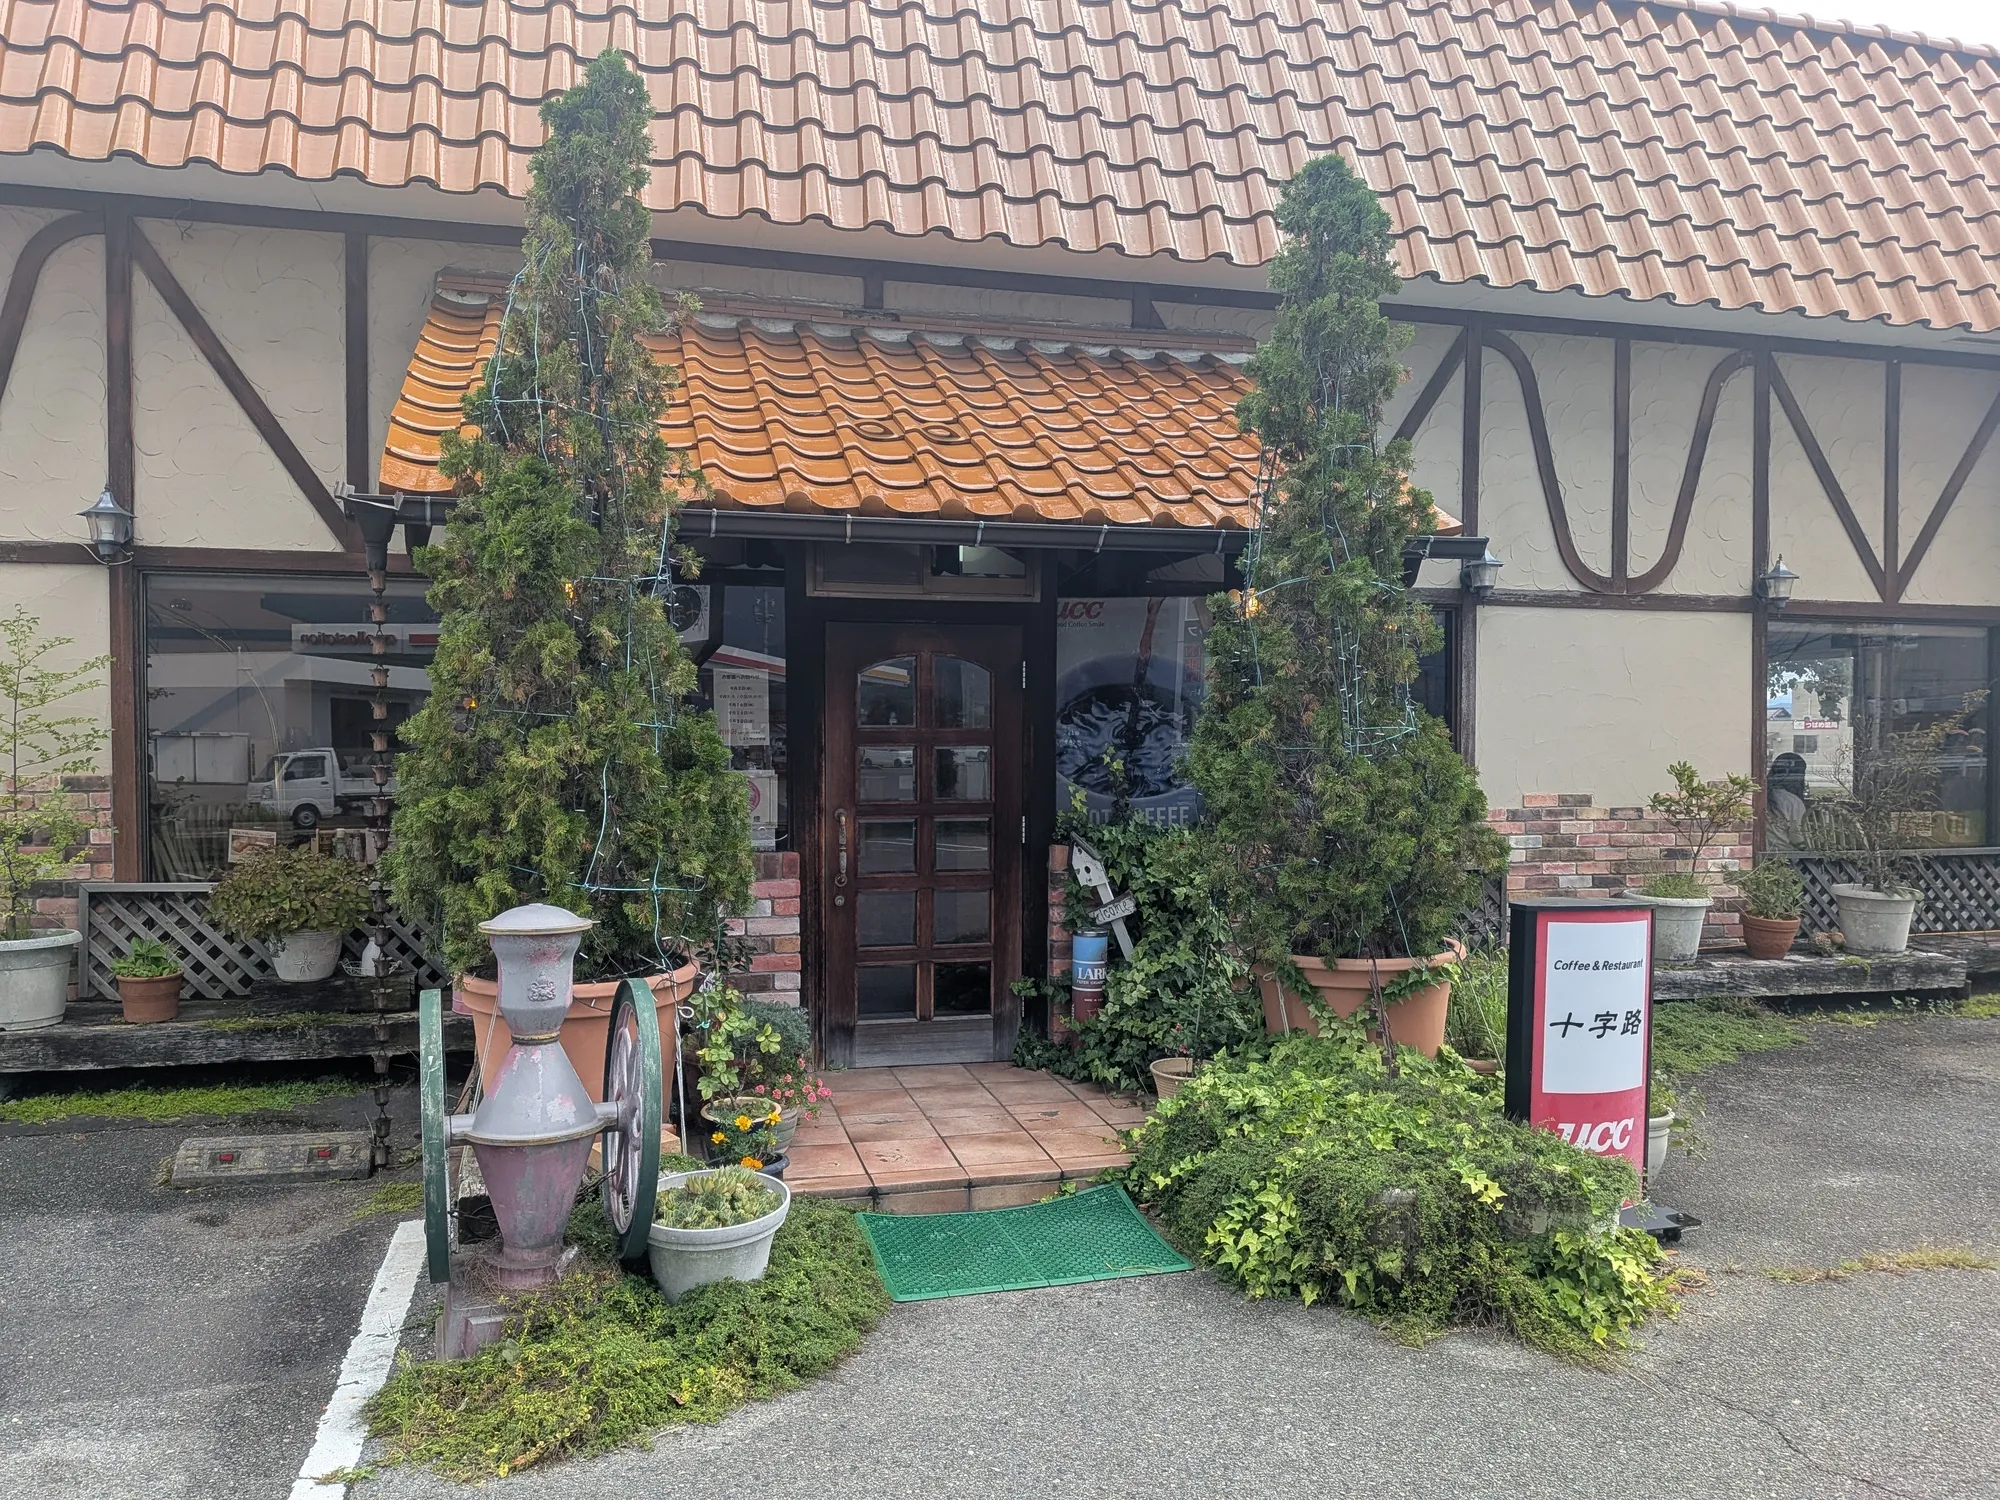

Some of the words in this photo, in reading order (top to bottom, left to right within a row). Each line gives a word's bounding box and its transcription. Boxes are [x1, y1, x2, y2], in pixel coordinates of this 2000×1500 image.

[1089, 808, 1112, 826] OT
[1095, 900, 1131, 922] elcome
[1553, 959, 1590, 972] Coffee
[1591, 960, 1601, 972] &
[1601, 957, 1644, 971] Restaurant
[1549, 1008, 1643, 1040] 十字路
[1557, 1117, 1635, 1153] UCC
